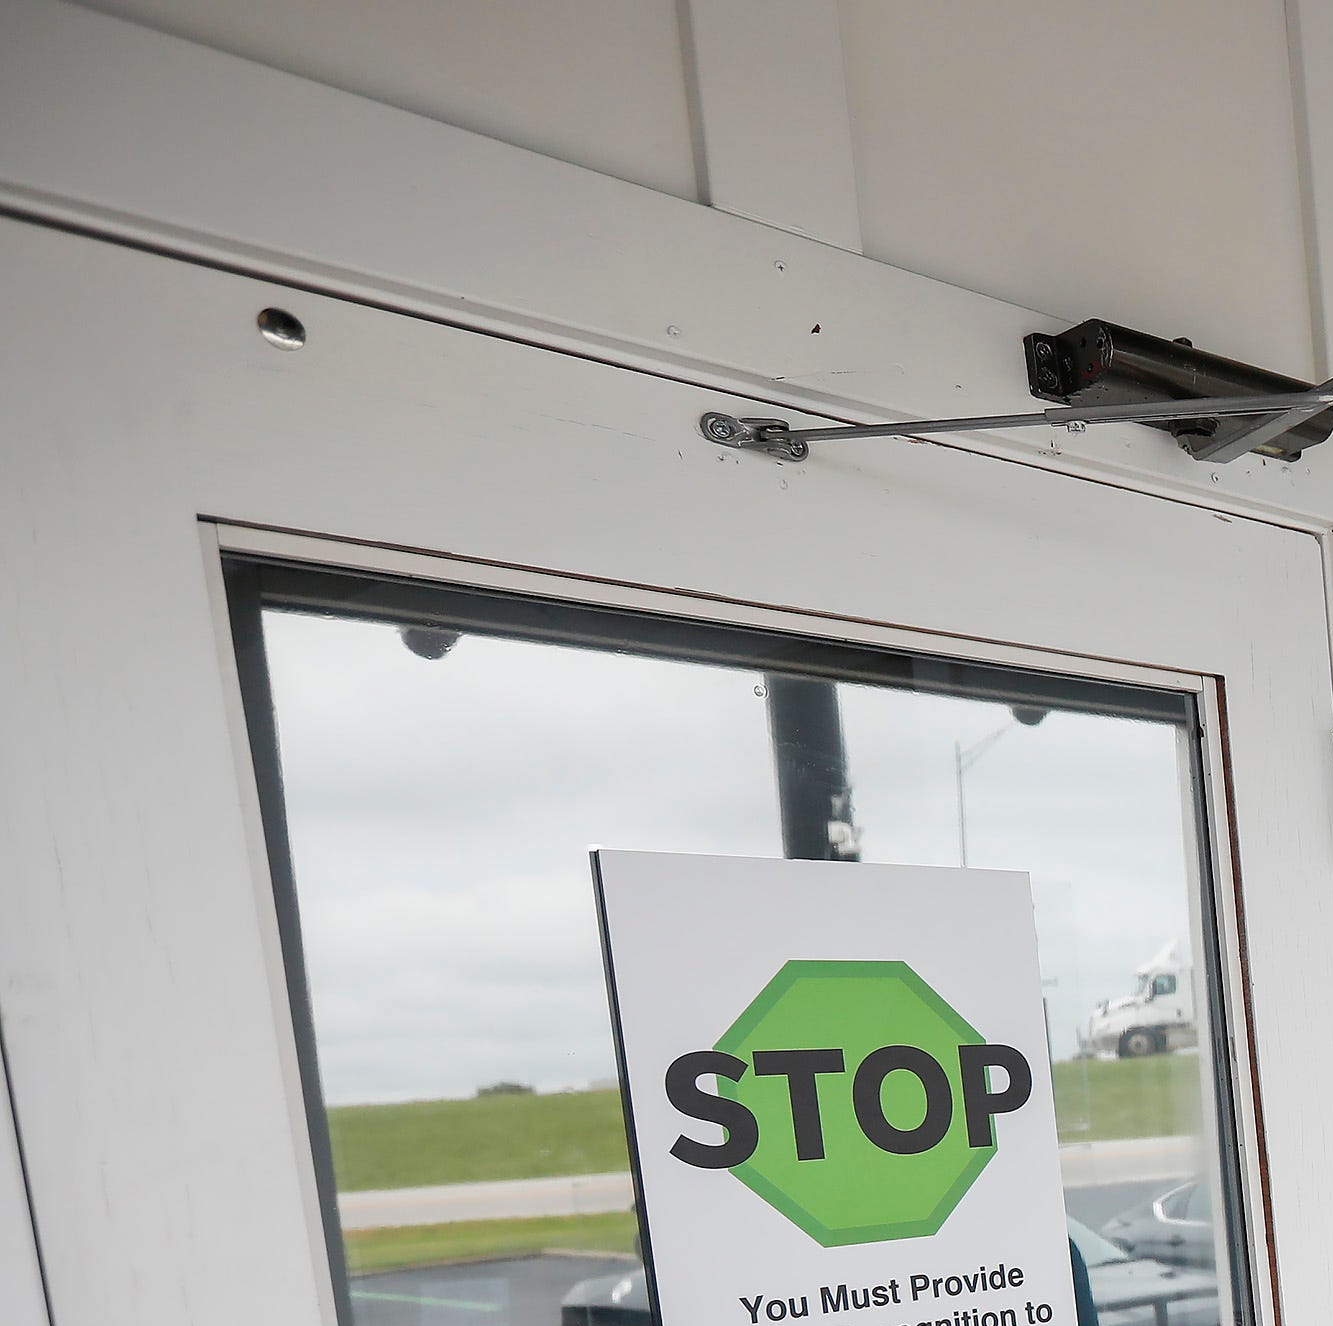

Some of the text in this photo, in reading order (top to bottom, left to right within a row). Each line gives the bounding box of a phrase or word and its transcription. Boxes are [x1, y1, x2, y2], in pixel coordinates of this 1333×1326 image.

[663, 1043, 1033, 1170] STOP
[738, 1263, 1025, 1324] You Must Provide
[1024, 1300, 1054, 1326] to
